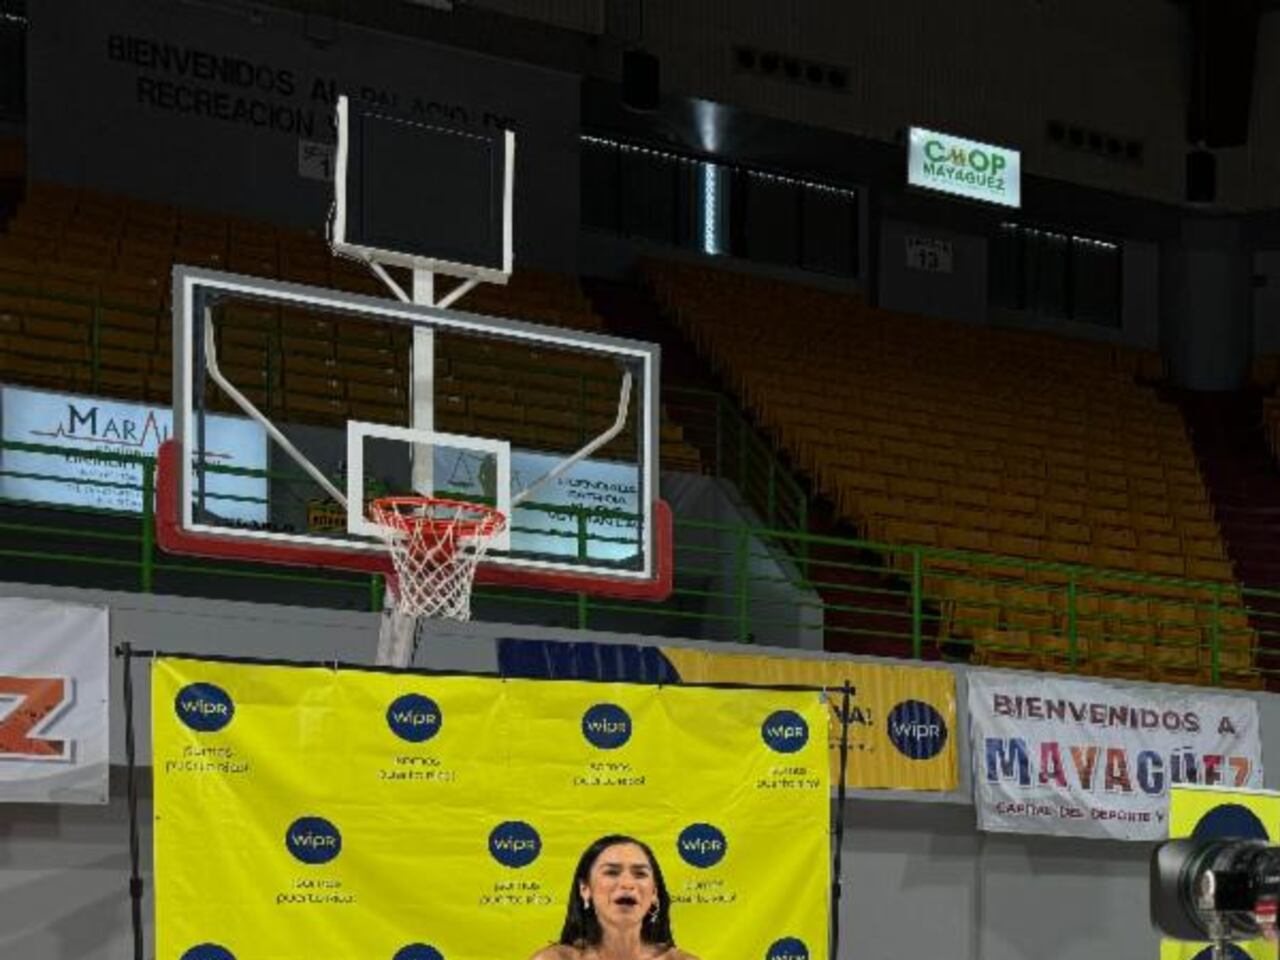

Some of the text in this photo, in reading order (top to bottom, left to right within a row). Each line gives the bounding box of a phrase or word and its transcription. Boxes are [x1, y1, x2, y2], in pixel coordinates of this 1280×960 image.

[107, 33, 295, 96] BIENVENIDOS
[137, 76, 314, 137] RECREACION
[993, 693, 1236, 735] BIENVENIDOS A
[995, 801, 1053, 816] CAPITAL
[1060, 806, 1085, 819] DEL
[1091, 808, 1151, 823] DEPORTE
